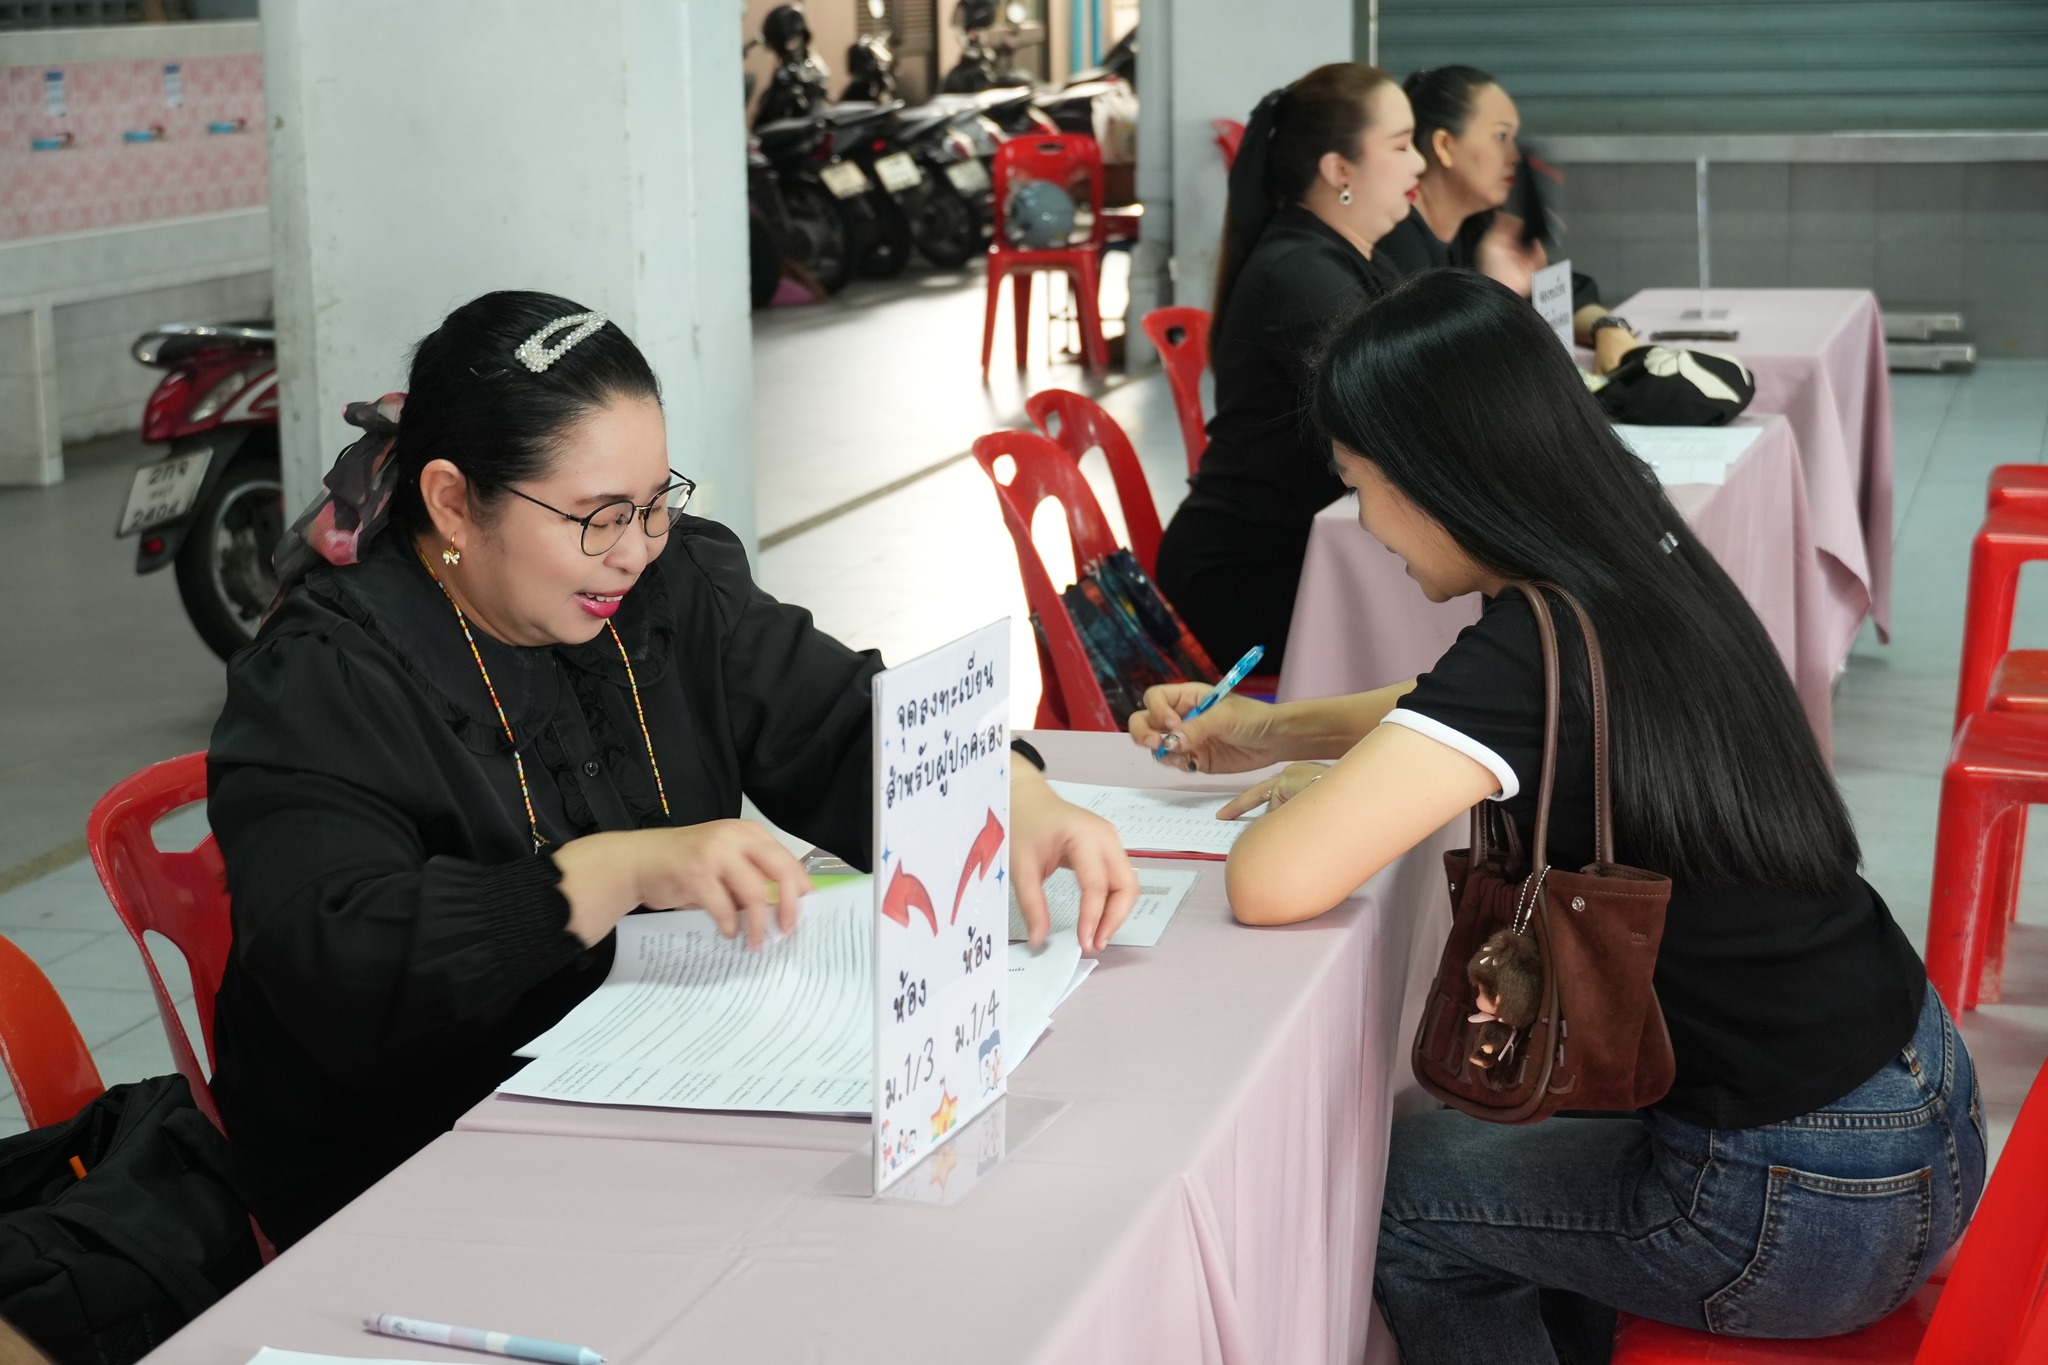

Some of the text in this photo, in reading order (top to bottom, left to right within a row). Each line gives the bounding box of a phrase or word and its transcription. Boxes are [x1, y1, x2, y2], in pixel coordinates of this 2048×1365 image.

[897, 650, 993, 753] จุดลงทะเบียน
[886, 729, 1002, 809] สำหรับผู้ปกครอง
[963, 926, 992, 974] ห้อง
[893, 970, 927, 1023] ห้อง
[955, 989, 1000, 1053] ม.1/4
[886, 1037, 934, 1110] ม.1/3
